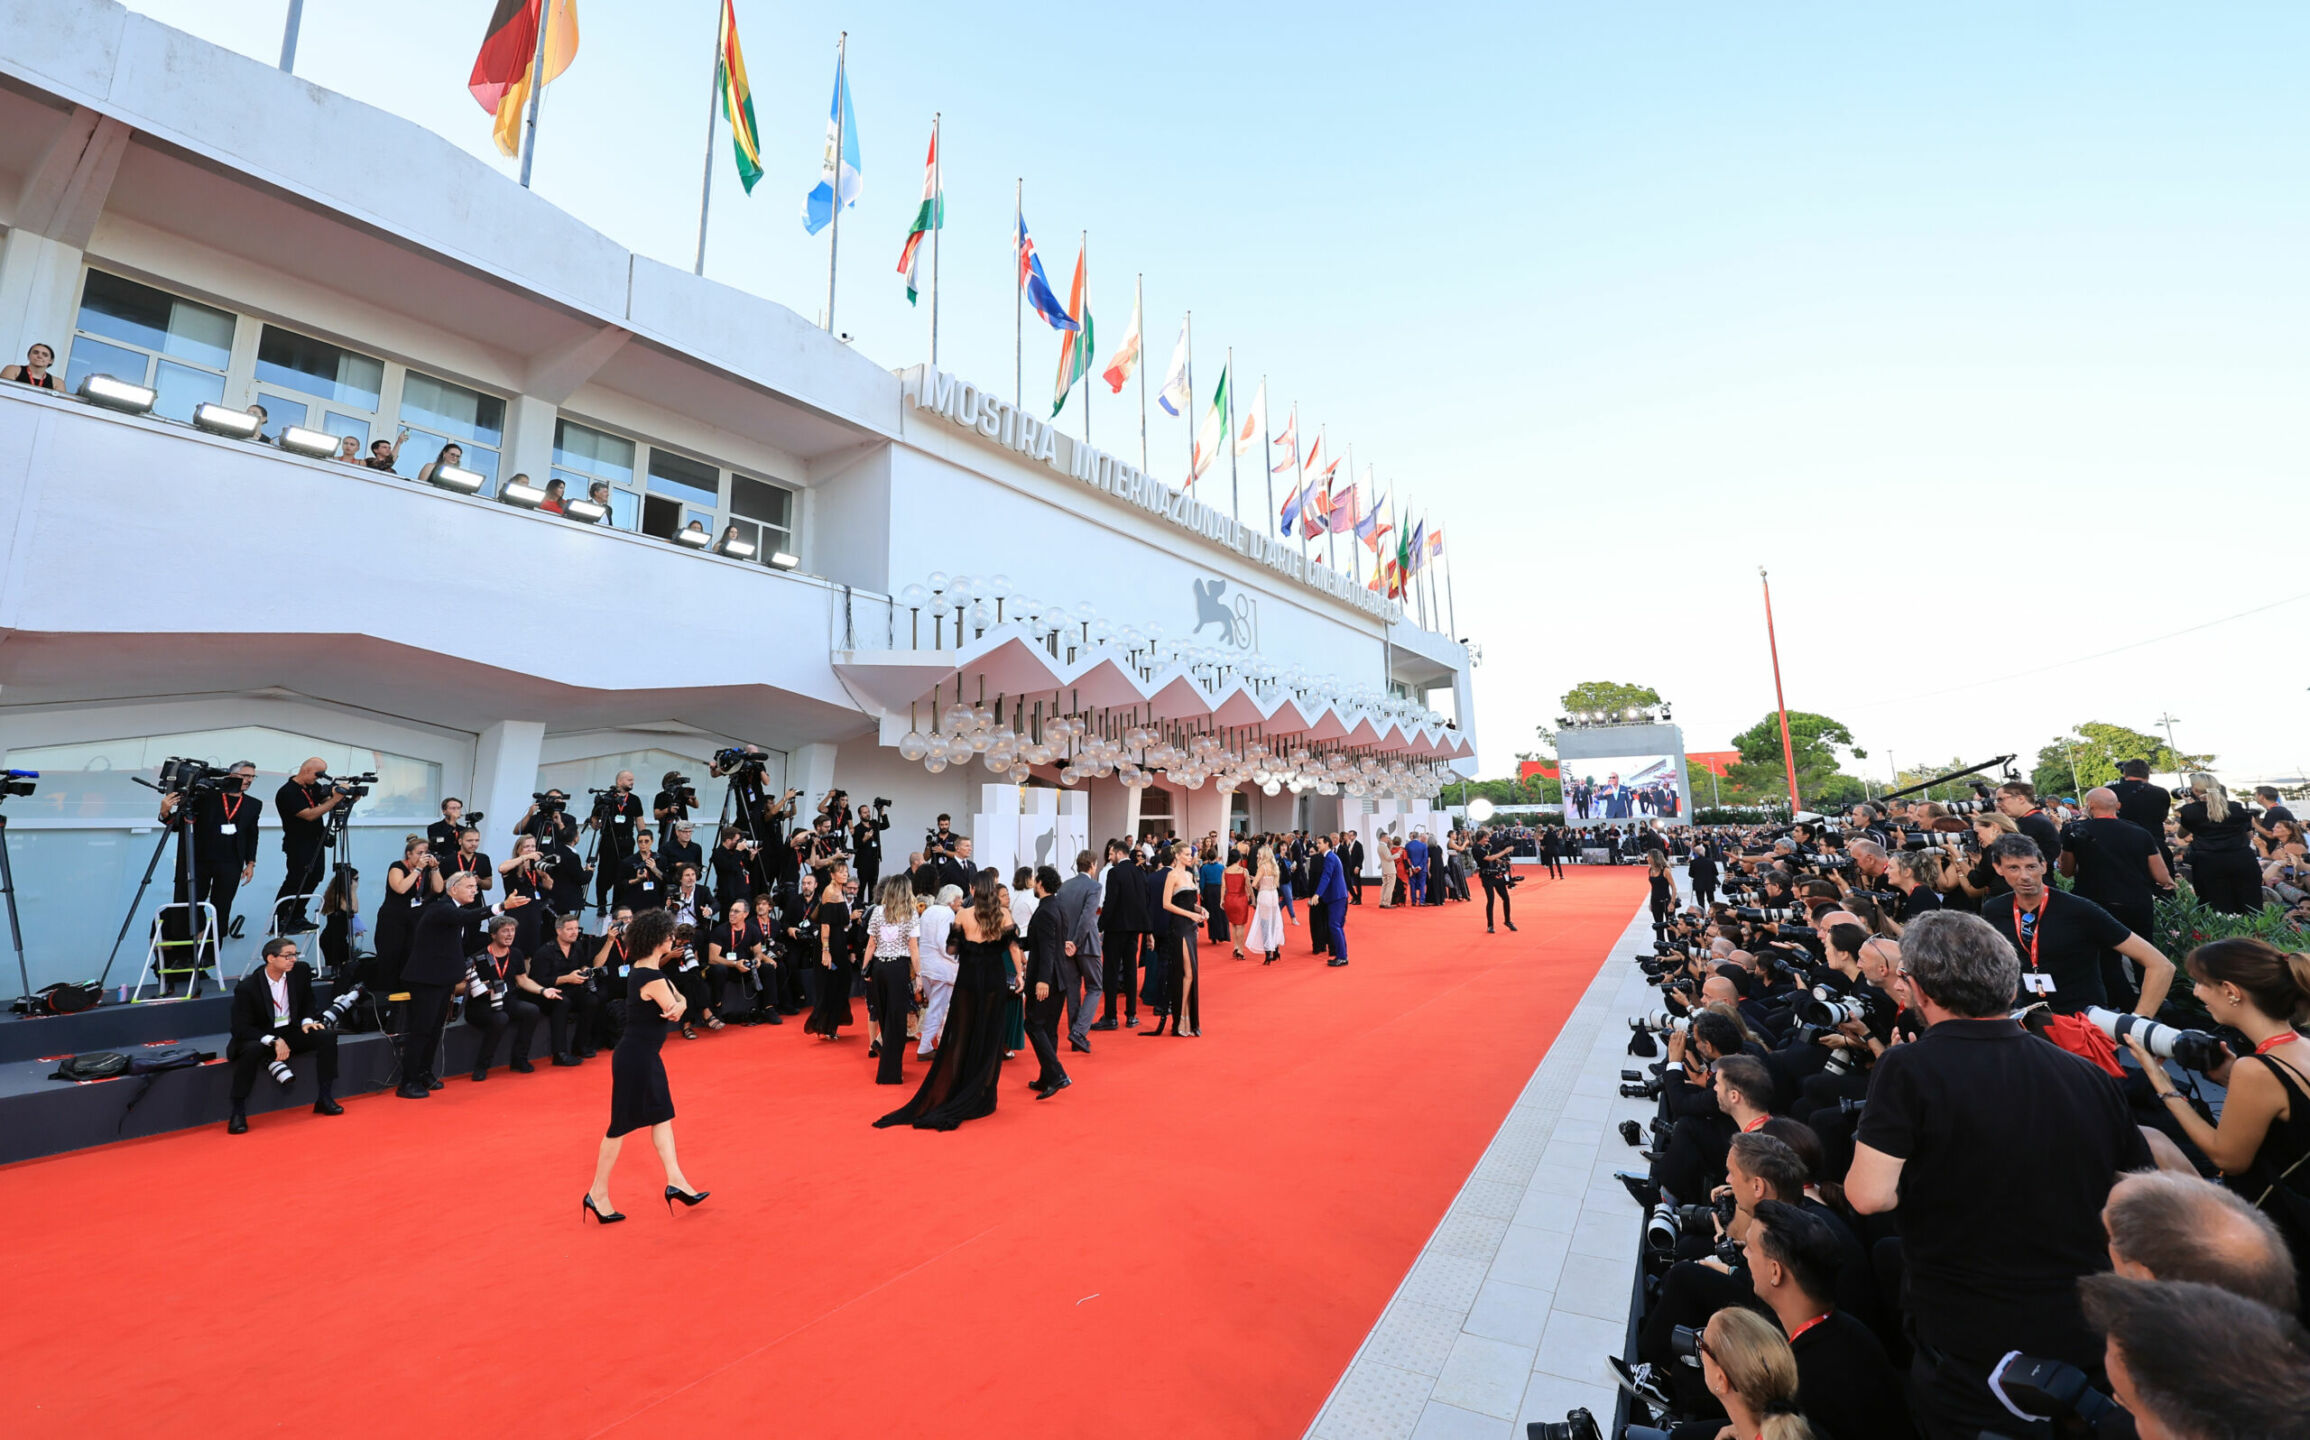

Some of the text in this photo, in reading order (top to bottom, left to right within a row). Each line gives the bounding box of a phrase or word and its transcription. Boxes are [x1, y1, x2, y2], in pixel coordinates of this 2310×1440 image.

[922, 363, 1057, 465] MOSTRA
[1071, 439, 1244, 551] INTERNAZIONALE
[1250, 530, 1301, 578] D'ARTE
